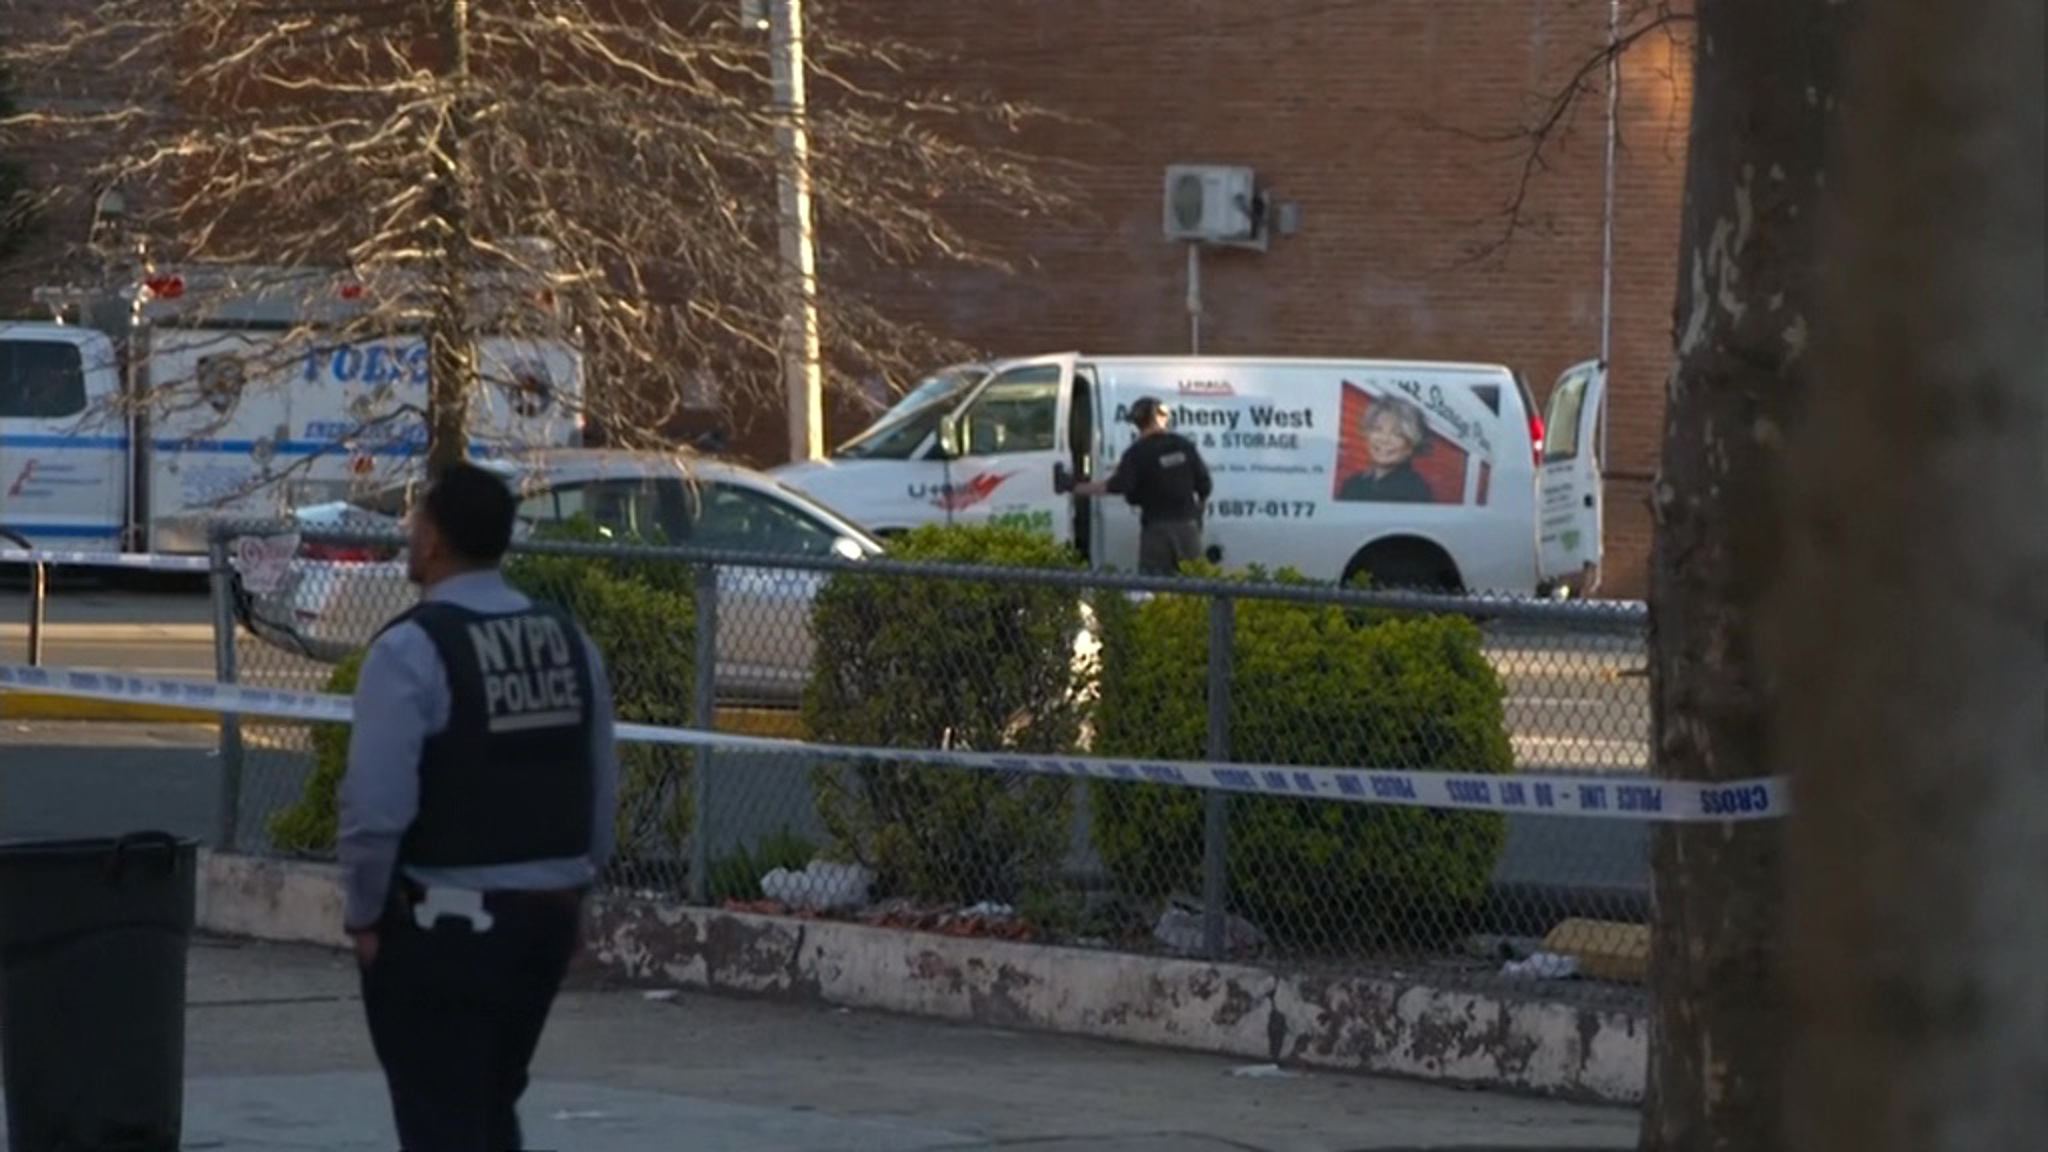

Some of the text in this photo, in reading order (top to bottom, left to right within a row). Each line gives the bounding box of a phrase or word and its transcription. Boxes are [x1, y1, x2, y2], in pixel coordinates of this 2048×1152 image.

[1114, 404, 1315, 430] Agheny West
[1202, 435, 1216, 448] &
[1222, 433, 1299, 449] STORAGE
[1219, 499, 1316, 518] 687-0177
[469, 616, 570, 671] NYPD
[486, 668, 581, 714] POLICE
[1369, 774, 1416, 800] POLICE
[1445, 778, 1491, 804] CROSS
[1498, 780, 1524, 806] NOT
[1533, 782, 1553, 808] DO
[1577, 783, 1607, 810] LINE
[1616, 785, 1663, 813] POLICE
[1699, 785, 1770, 815] CROSS
